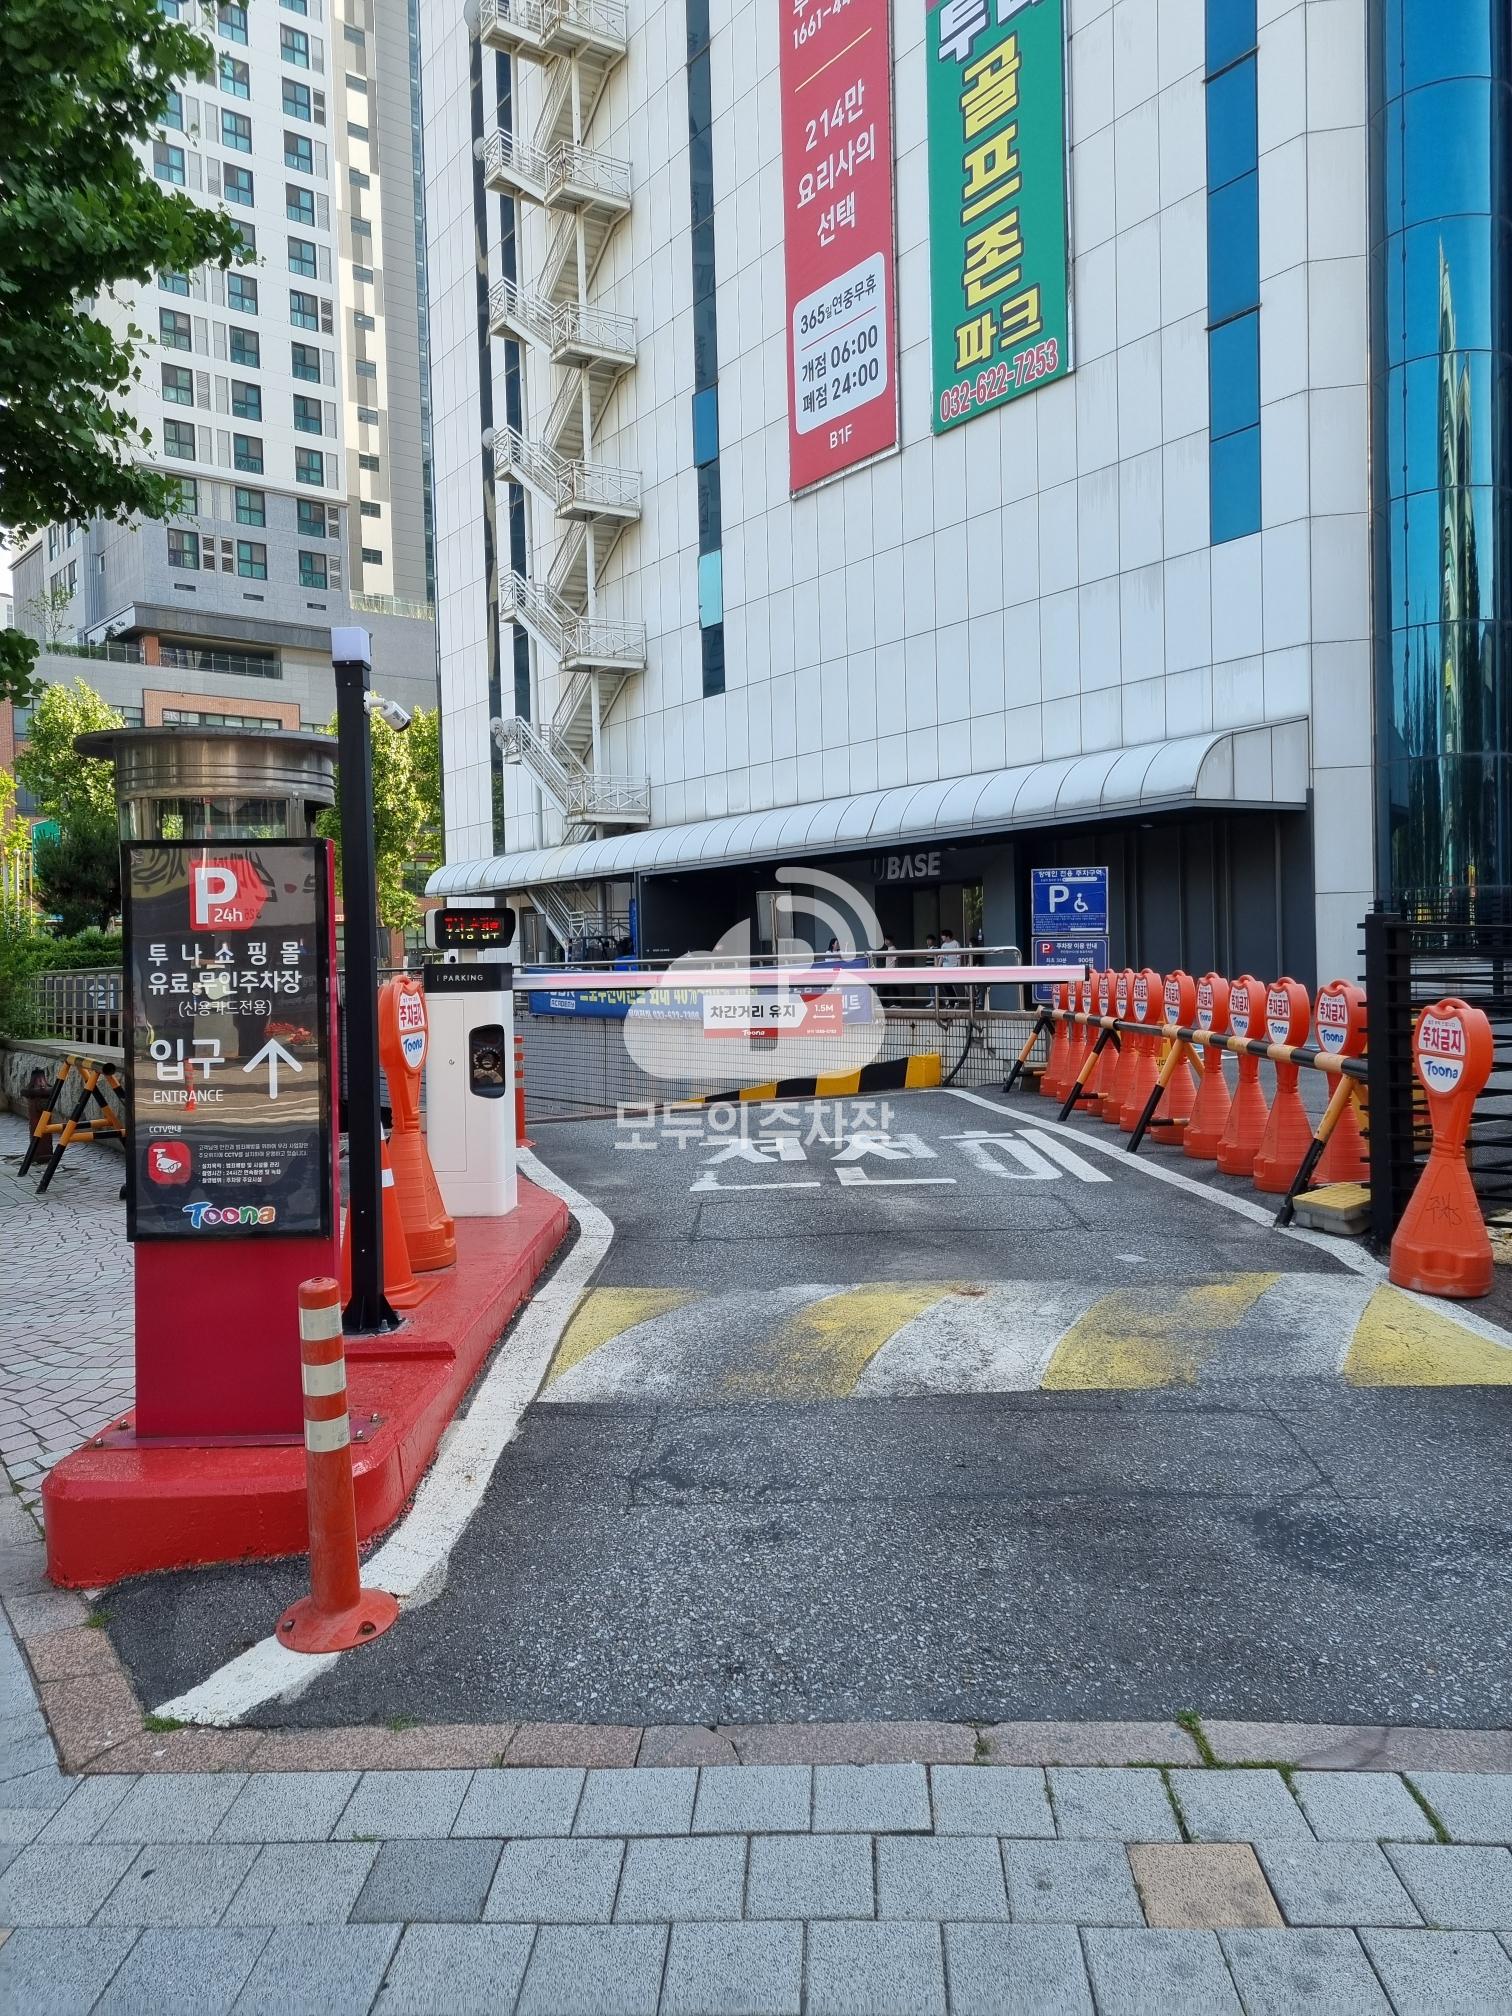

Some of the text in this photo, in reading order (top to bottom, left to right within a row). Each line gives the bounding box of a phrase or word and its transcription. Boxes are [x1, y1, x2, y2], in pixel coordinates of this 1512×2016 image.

[805, 78, 865, 152] 214만
[797, 122, 875, 209] 요리사의
[816, 190, 855, 247] 선택
[801, 324, 878, 383] 개점 06:00
[802, 357, 879, 413] 폐점 24:00
[939, 337, 1060, 423] 032-622-7253
[829, 424, 853, 449] B1F
[195, 867, 238, 925] P
[1049, 885, 1070, 913] P
[214, 907, 243, 923] 24h
[148, 970, 302, 996] 유료 무인주차장
[442, 974, 484, 982] PARKING
[178, 999, 272, 1018] (신용카드전용)
[709, 1003, 796, 1019] 차간거리 유지
[814, 1003, 834, 1013] 1.5M
[1231, 994, 1249, 1012] 주차금지
[1268, 998, 1289, 1017] 주차금지
[1319, 1002, 1346, 1022] 주차금지
[1232, 1016, 1248, 1029] Toona
[1270, 1022, 1288, 1035] Toona
[741, 1029, 766, 1037] Toona
[1320, 1029, 1344, 1043] Toona
[1423, 1026, 1462, 1053] 주차금지
[150, 1038, 226, 1081] 입구
[1424, 1060, 1459, 1079] Toona
[153, 1089, 224, 1103] ENTRANCE
[149, 1125, 182, 1134] CCTV안내
[182, 1201, 276, 1228] Toona
